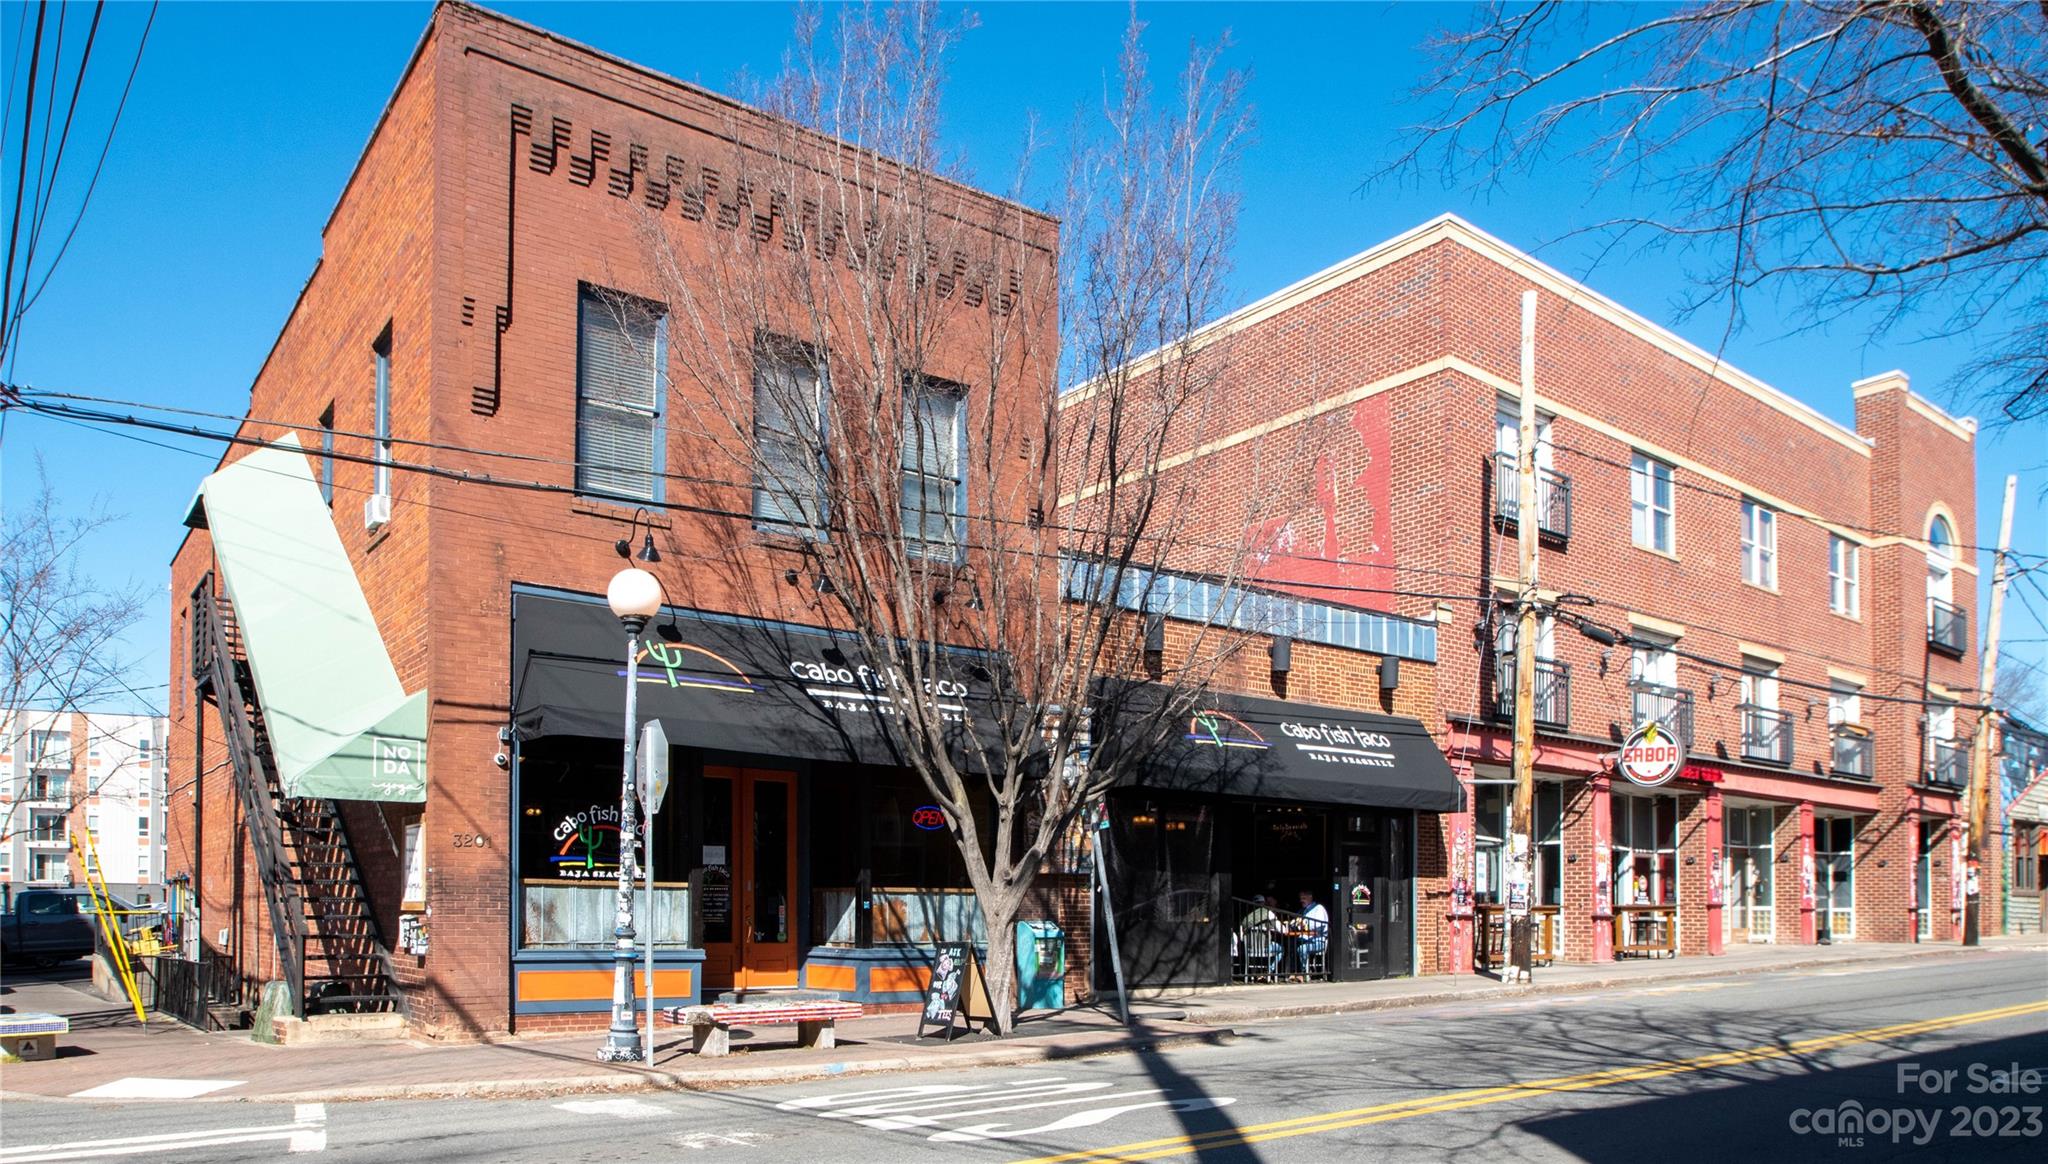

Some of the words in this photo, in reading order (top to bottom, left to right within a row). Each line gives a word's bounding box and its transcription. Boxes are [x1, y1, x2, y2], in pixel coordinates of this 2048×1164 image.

[790, 661, 854, 684] cabo
[822, 699, 870, 712] BAJA
[1280, 721, 1322, 740] cabo
[1320, 723, 1356, 746] fish
[1351, 726, 1391, 748] taco
[383, 745, 412, 760] NO
[1308, 752, 1339, 763] BAJA
[1341, 756, 1395, 768] SEAGRILL
[1624, 746, 1677, 763] SABOR
[383, 760, 411, 775] DA
[372, 782, 425, 796] yoga
[553, 811, 588, 841] cabo
[589, 804, 619, 825] fish
[912, 810, 945, 825] OPEN
[452, 834, 493, 848] 3201
[560, 869, 590, 878] BAJA
